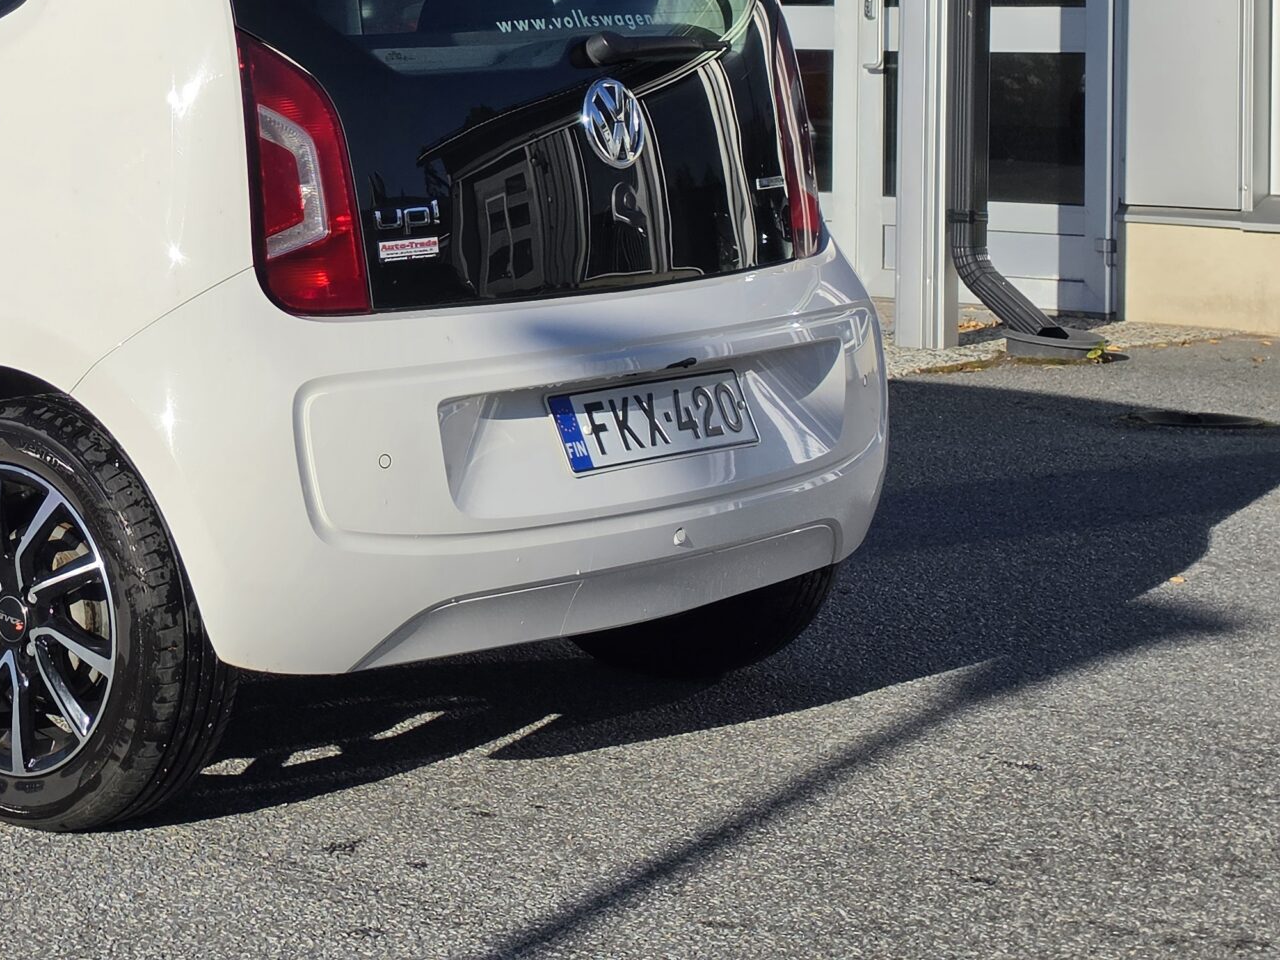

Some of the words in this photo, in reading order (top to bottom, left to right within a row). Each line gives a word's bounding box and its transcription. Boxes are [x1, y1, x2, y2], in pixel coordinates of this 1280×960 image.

[374, 199, 441, 235] up!
[566, 440, 588, 459] FIN
[583, 381, 744, 456] FKX-420
